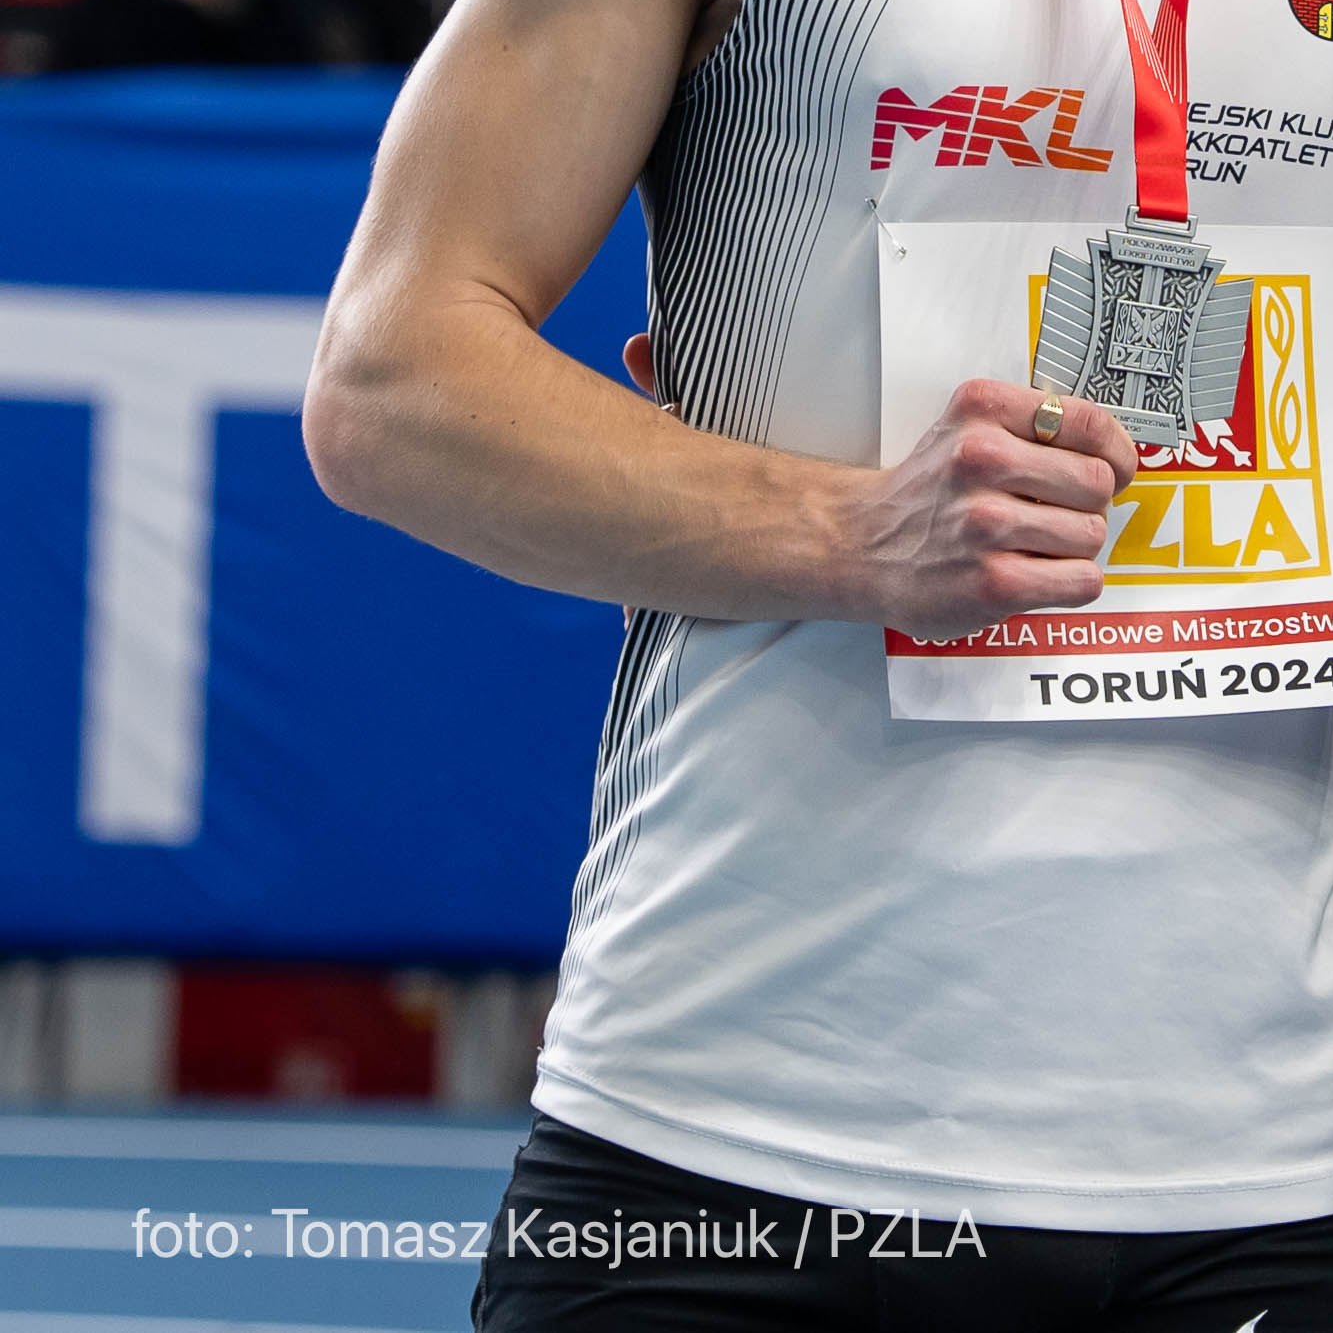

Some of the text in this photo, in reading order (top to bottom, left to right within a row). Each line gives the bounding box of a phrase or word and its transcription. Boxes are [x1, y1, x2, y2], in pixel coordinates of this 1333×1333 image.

[870, 85, 1114, 172] MKL
[1187, 102, 1273, 130] EJSKI
[1186, 157, 1248, 185] RUŃ
[1112, 346, 1171, 373] PZLA
[1106, 483, 1312, 569] ZLA
[1047, 621, 1164, 646] Halowe
[1030, 657, 1208, 705] TORUŃ
